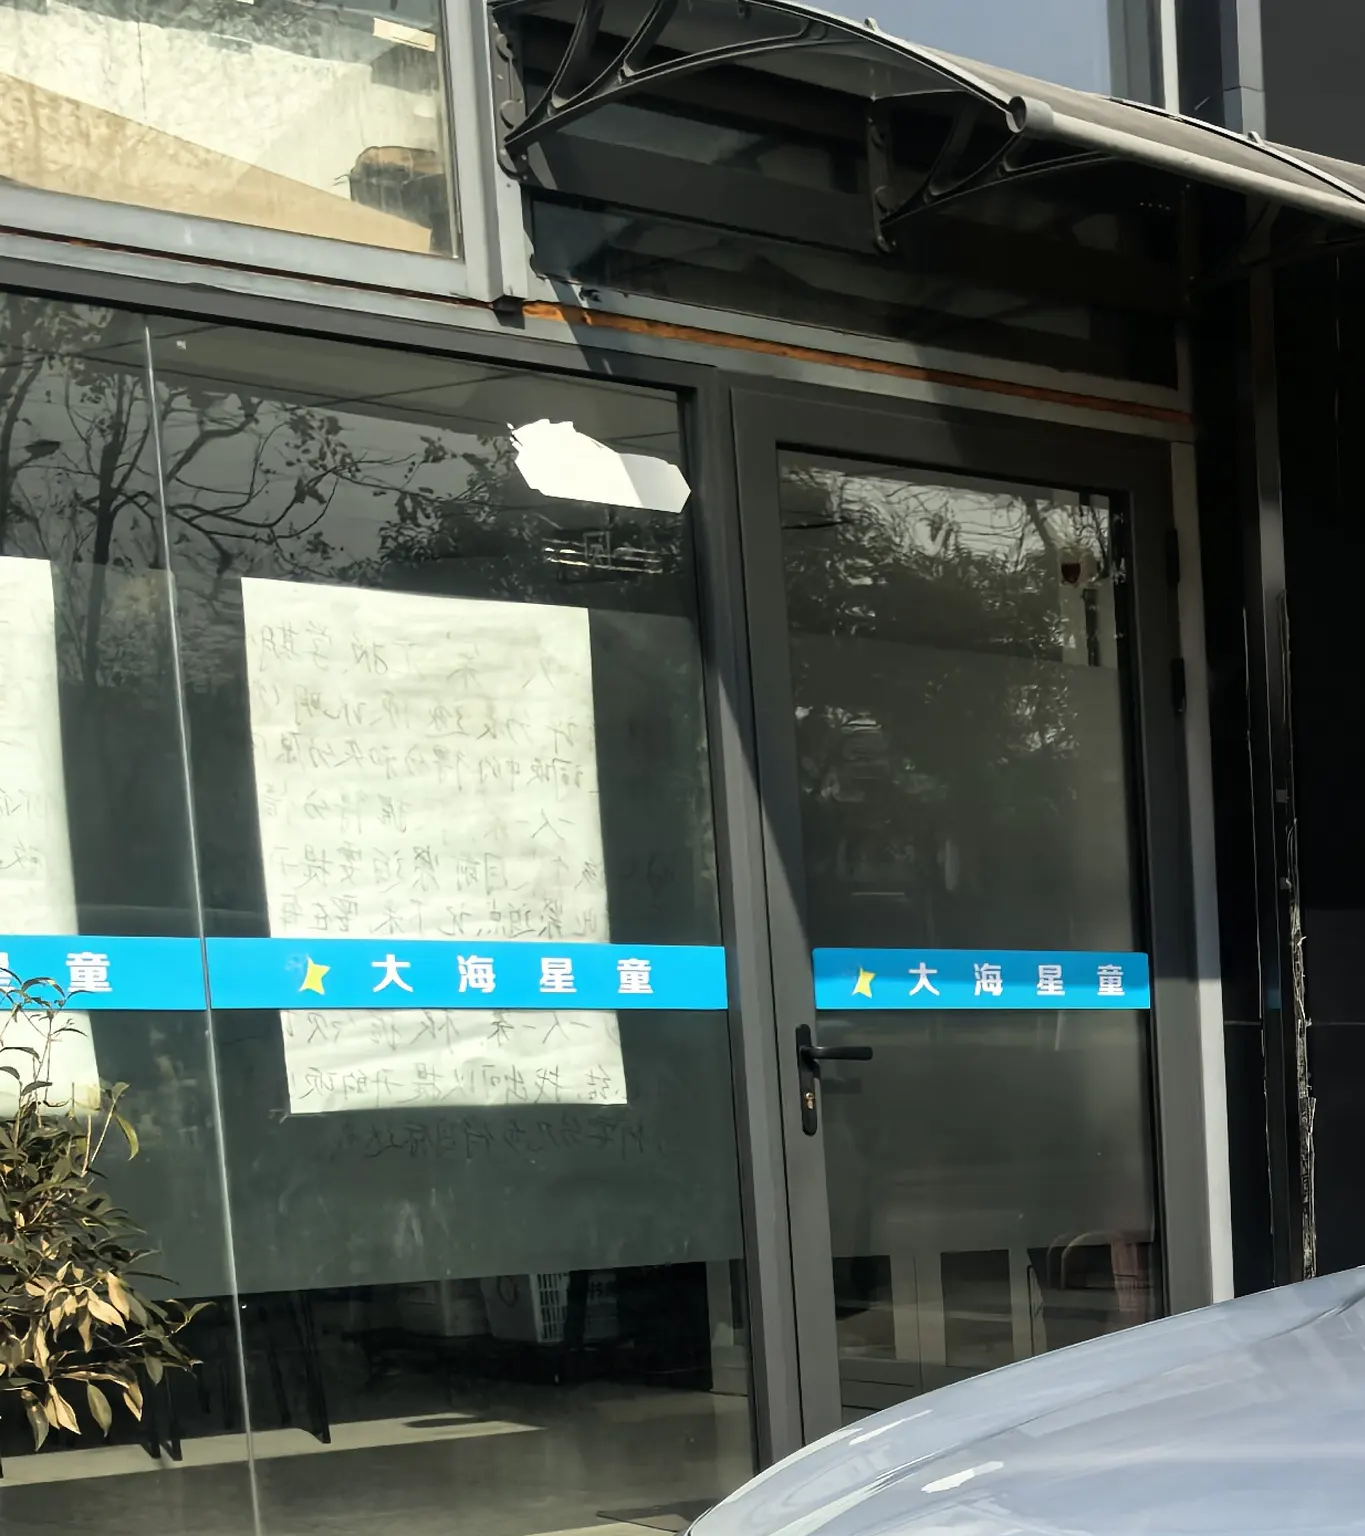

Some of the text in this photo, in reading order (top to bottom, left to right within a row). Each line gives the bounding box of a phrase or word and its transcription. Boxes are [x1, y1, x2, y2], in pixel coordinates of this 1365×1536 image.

[371, 953, 654, 994] 大海星童
[908, 962, 1126, 996] 大海星童
